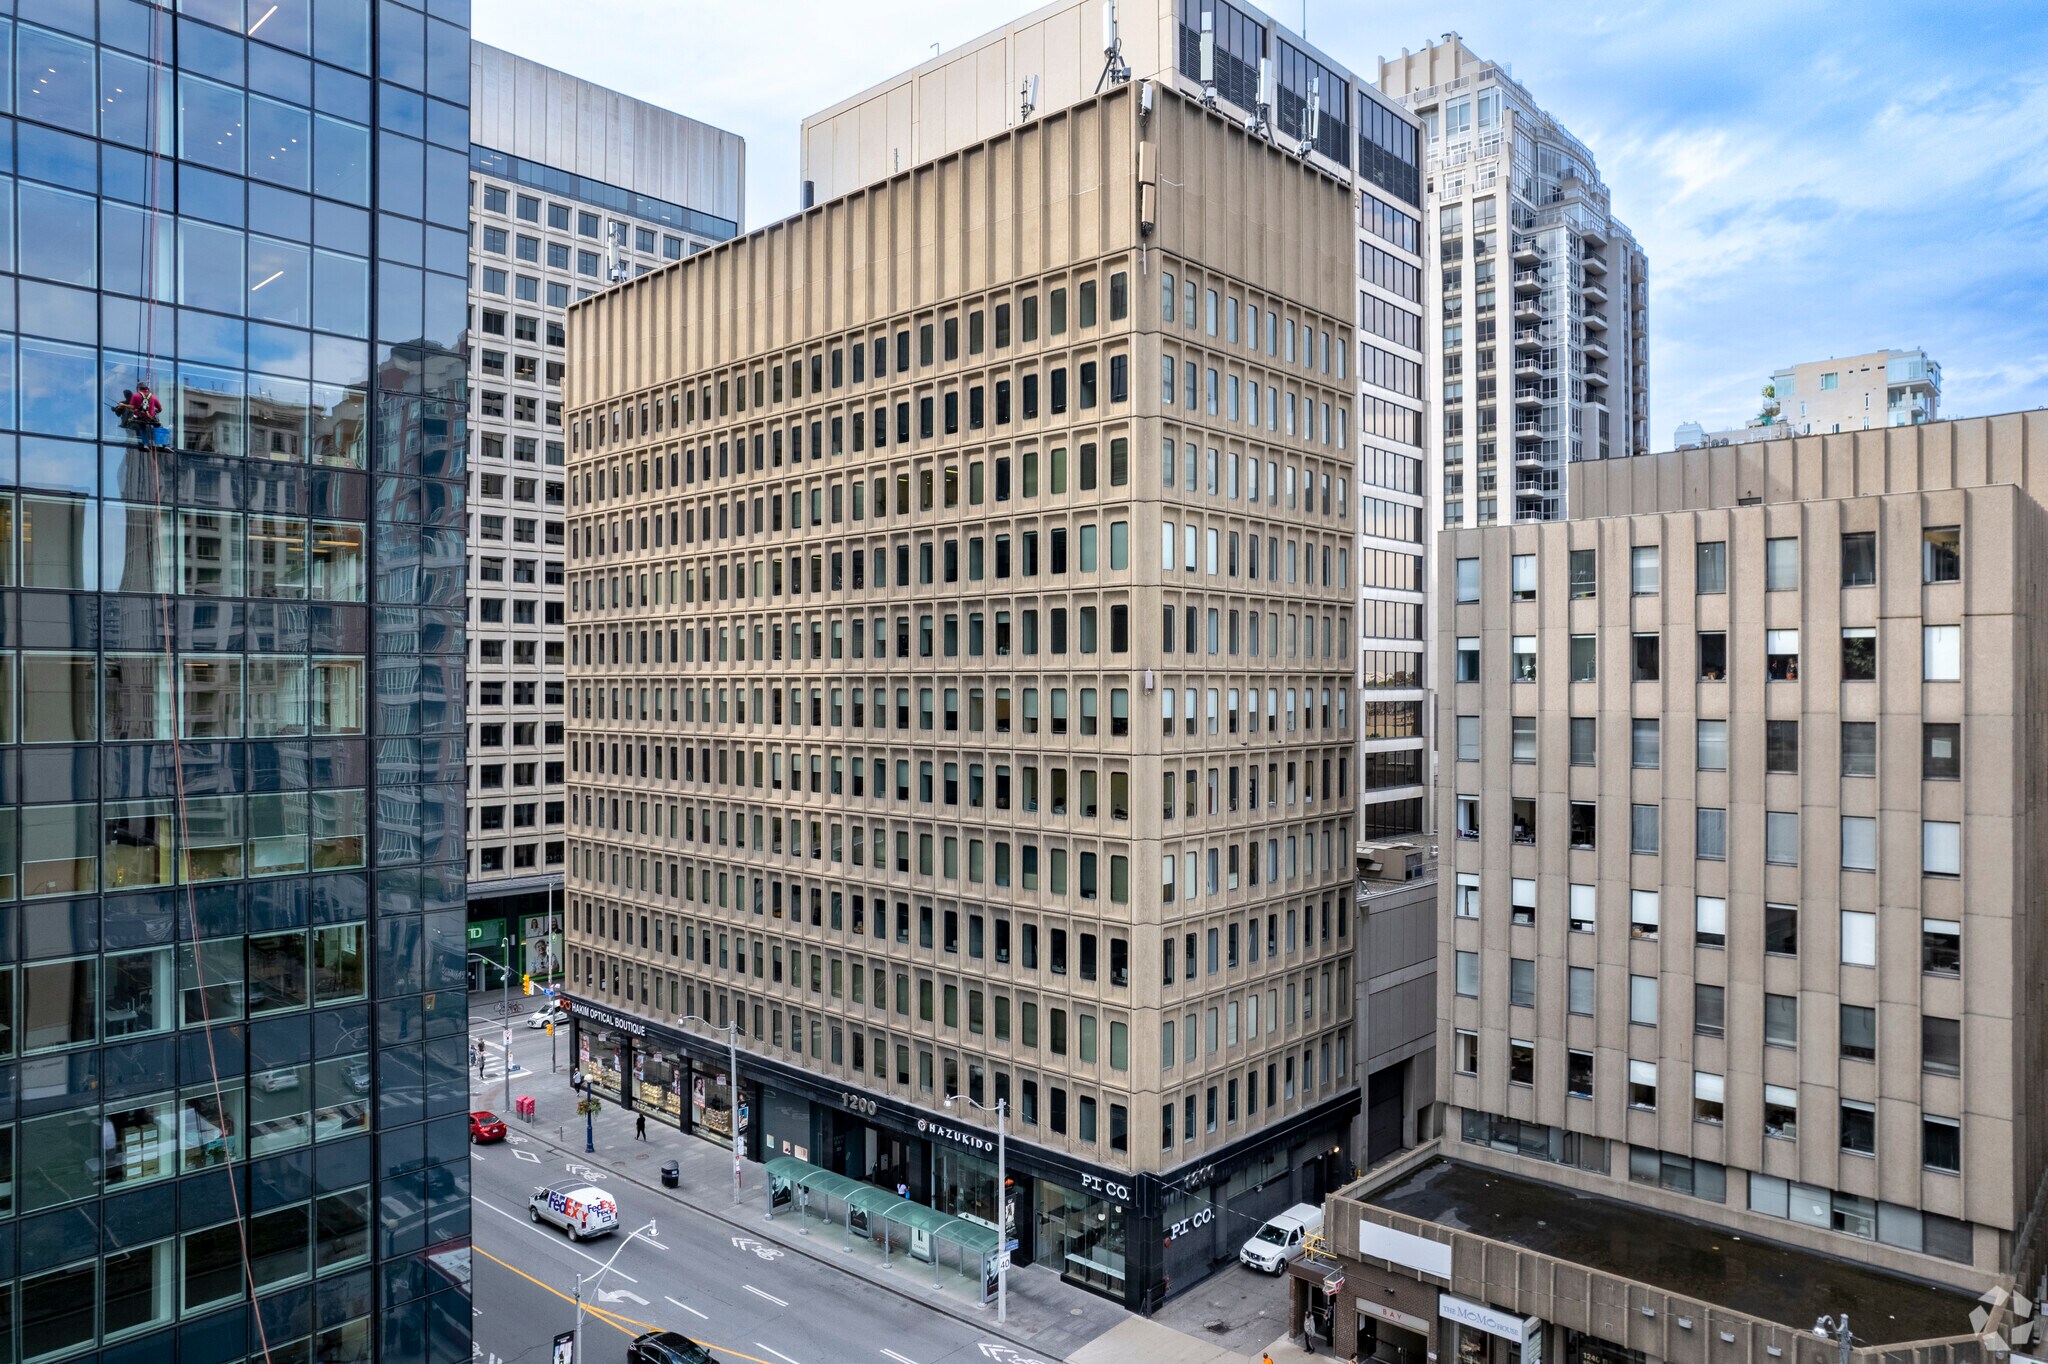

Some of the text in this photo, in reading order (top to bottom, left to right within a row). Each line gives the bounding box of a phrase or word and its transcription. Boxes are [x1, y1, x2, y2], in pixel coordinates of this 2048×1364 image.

[467, 927, 482, 939] TD
[571, 1002, 646, 1036] HAKIM OPTICAL BOUTIQUE
[841, 1092, 877, 1116] 1200
[929, 1123, 993, 1152] HAZUKIDO
[1081, 1173, 1130, 1201] PI CO.
[1170, 1208, 1215, 1240] PI CO.
[1000, 1259, 1009, 1270] 40
[1382, 1308, 1402, 1320] BAY
[1443, 1305, 1457, 1315] THE
[1496, 1323, 1519, 1336] HOUSE
